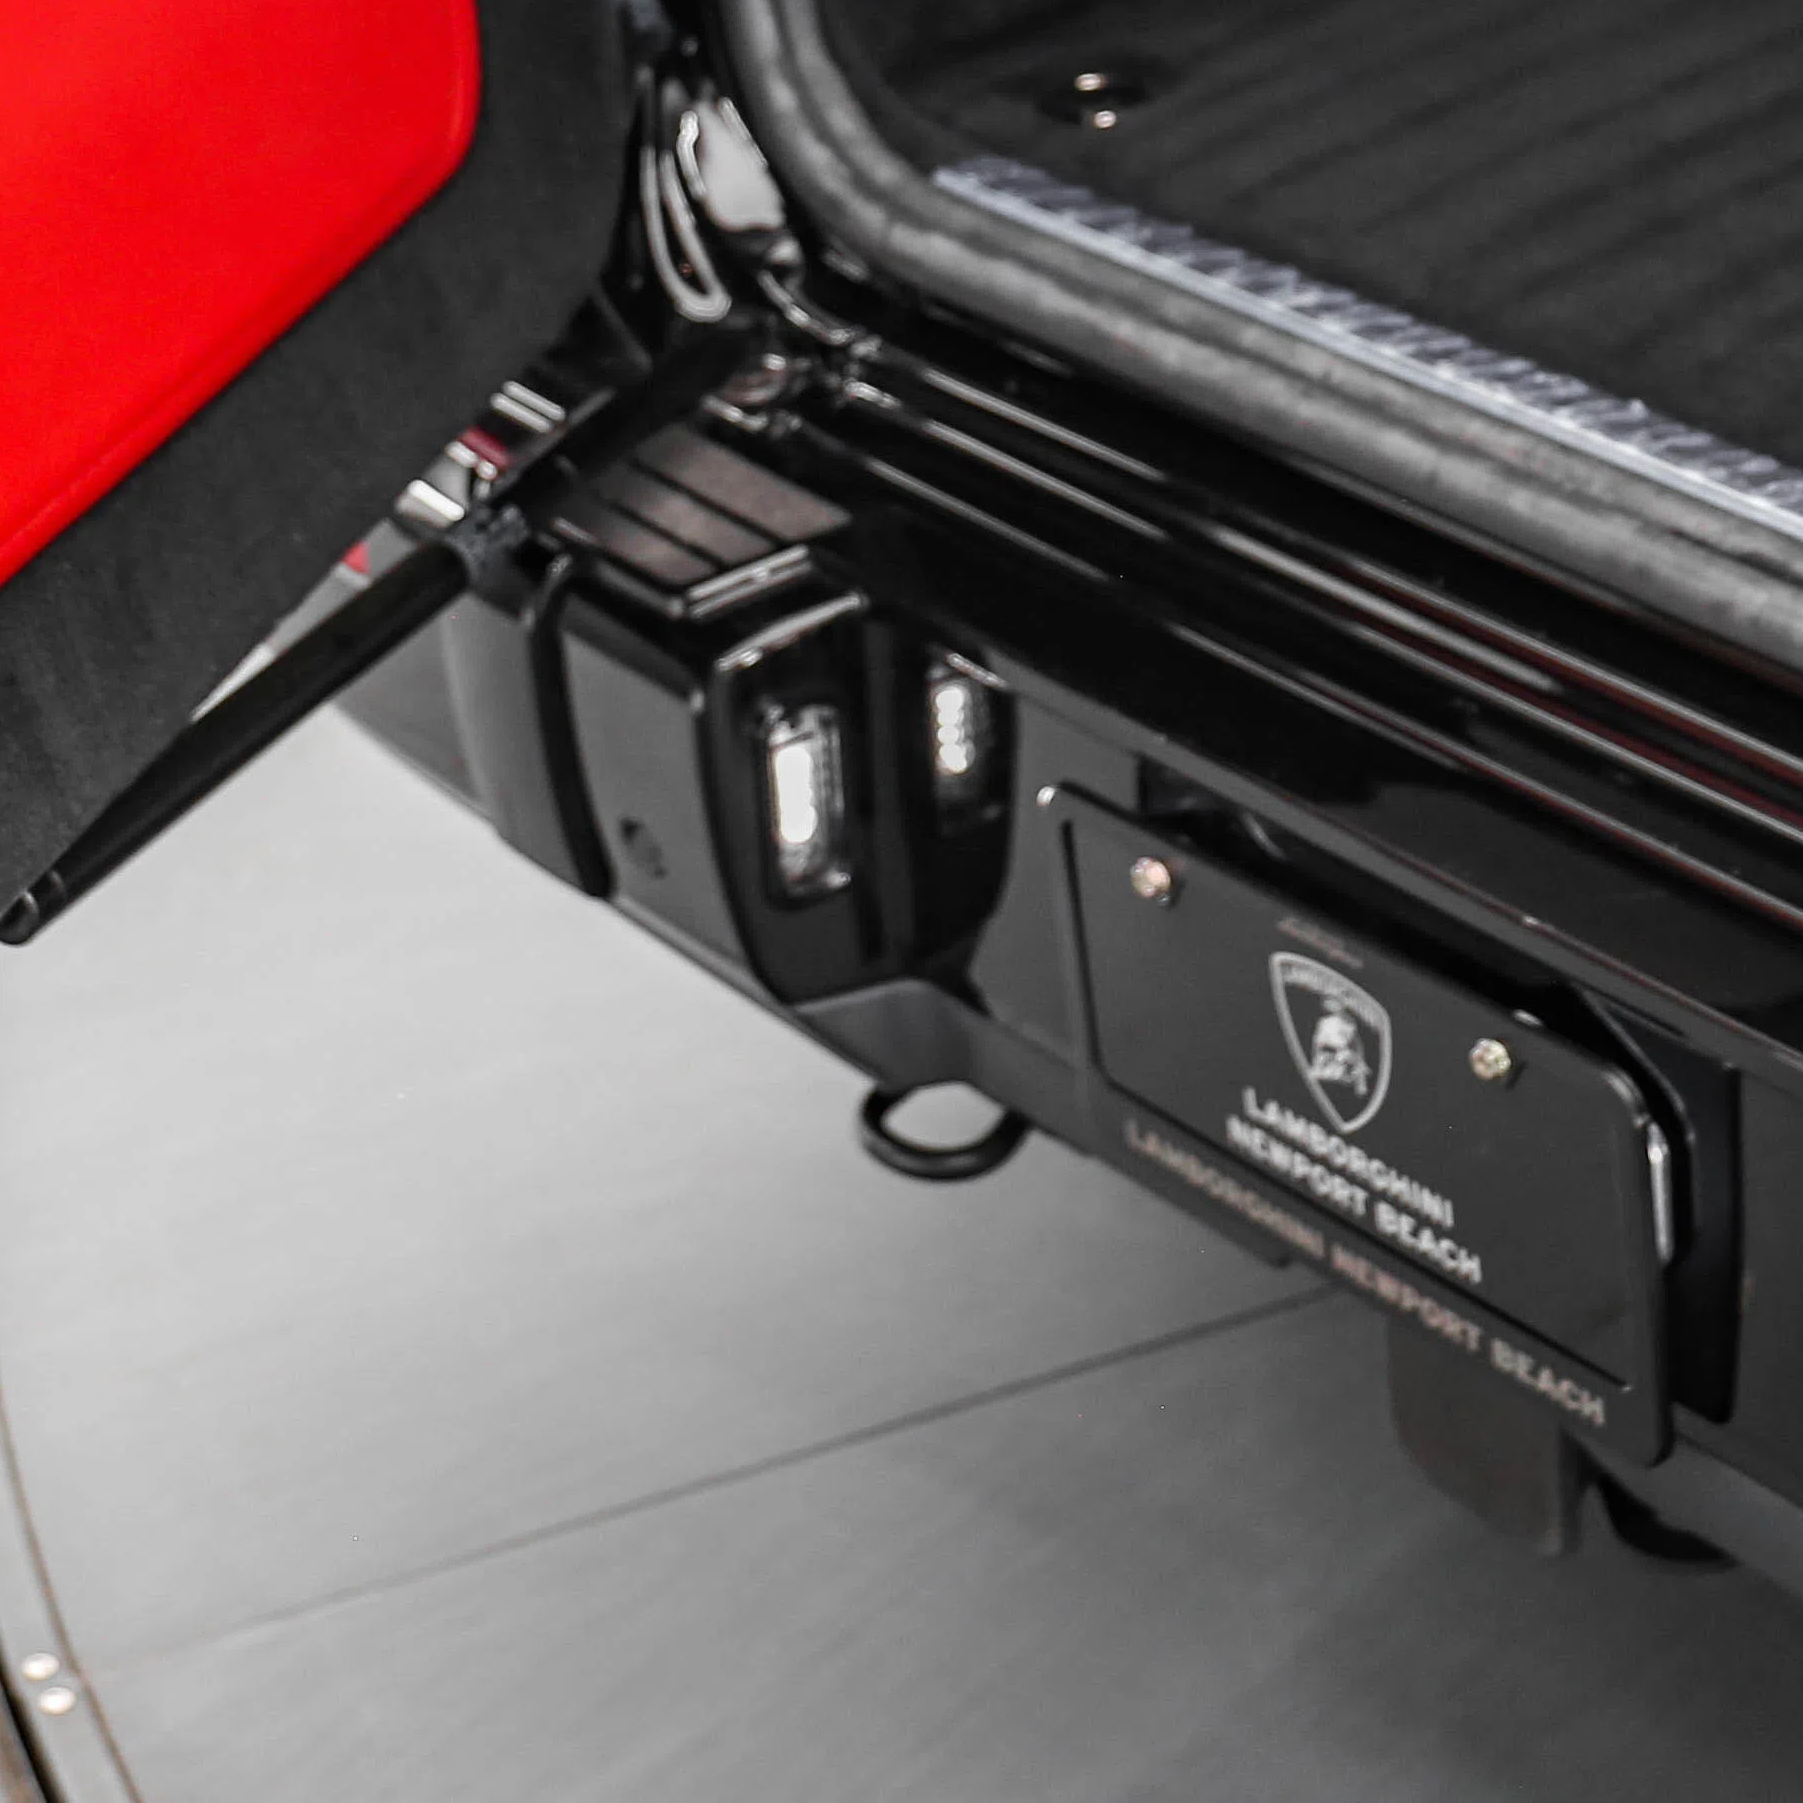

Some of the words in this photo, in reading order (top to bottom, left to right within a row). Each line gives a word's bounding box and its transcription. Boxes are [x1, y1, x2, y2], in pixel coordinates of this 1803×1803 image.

[1225, 1113, 1370, 1217] NEWPORT
[1372, 1199, 1483, 1285] BEACH
[1241, 1086, 1454, 1229] LAMBORGHINI
[1124, 1118, 1327, 1260] LAMBORGHINI
[1329, 1242, 1483, 1354] NEWPORT
[1489, 1336, 1608, 1428] BEACH
